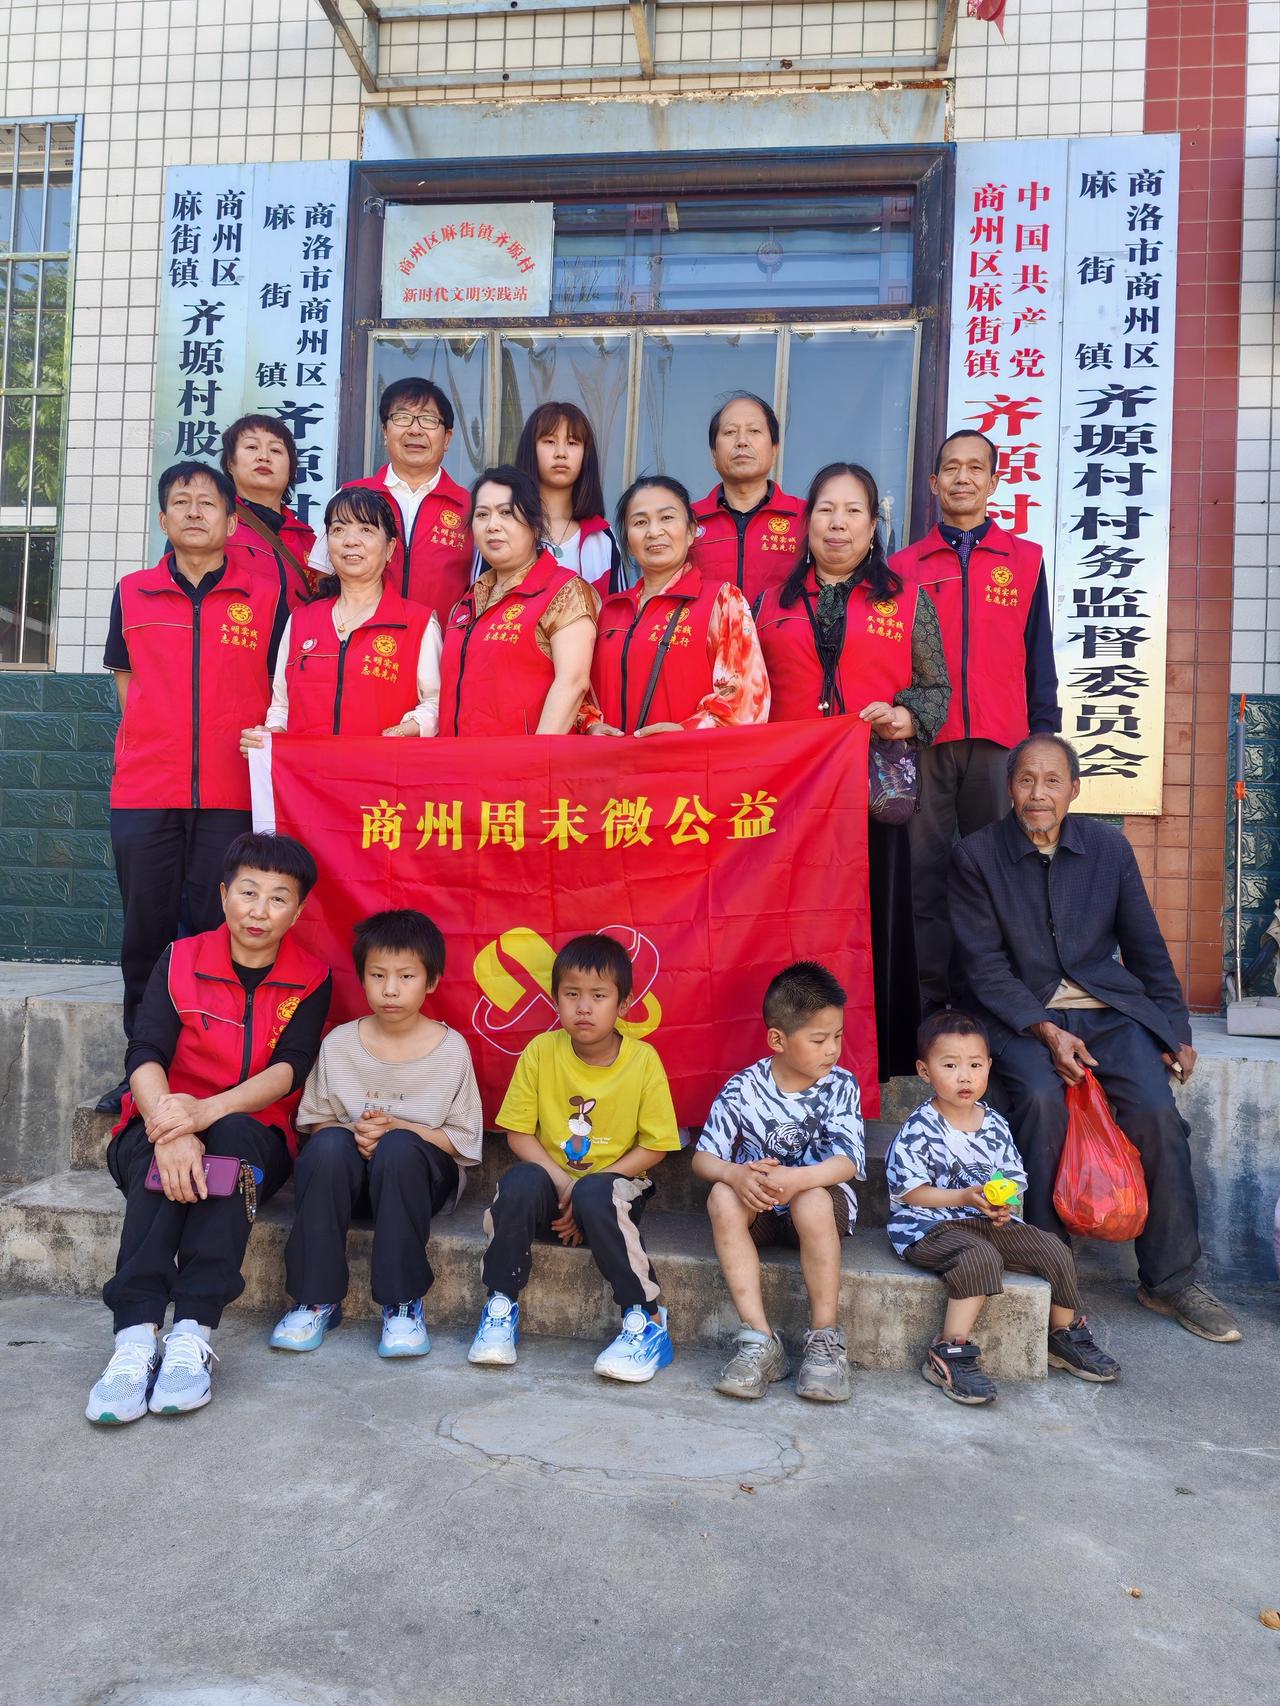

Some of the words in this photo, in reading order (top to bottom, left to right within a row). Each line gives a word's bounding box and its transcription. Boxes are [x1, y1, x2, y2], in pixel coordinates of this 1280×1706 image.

[169, 190, 203, 288] 麻街镇
[212, 189, 246, 287] 商州区
[255, 203, 296, 388] 麻街镇
[296, 202, 336, 387] 商洛市商州区
[403, 286, 528, 302] 新时代文明实践站
[963, 183, 1007, 378] 商州区麻街镇
[1008, 181, 1051, 378] 中国共产党
[1074, 169, 1118, 372] 麻街镇
[1123, 168, 1166, 369] 商洛市商州区
[174, 299, 226, 464] 齐塬村股
[1066, 383, 1158, 779] 齐塬村村务监督委员会
[360, 790, 778, 851] 商州周末微公益
